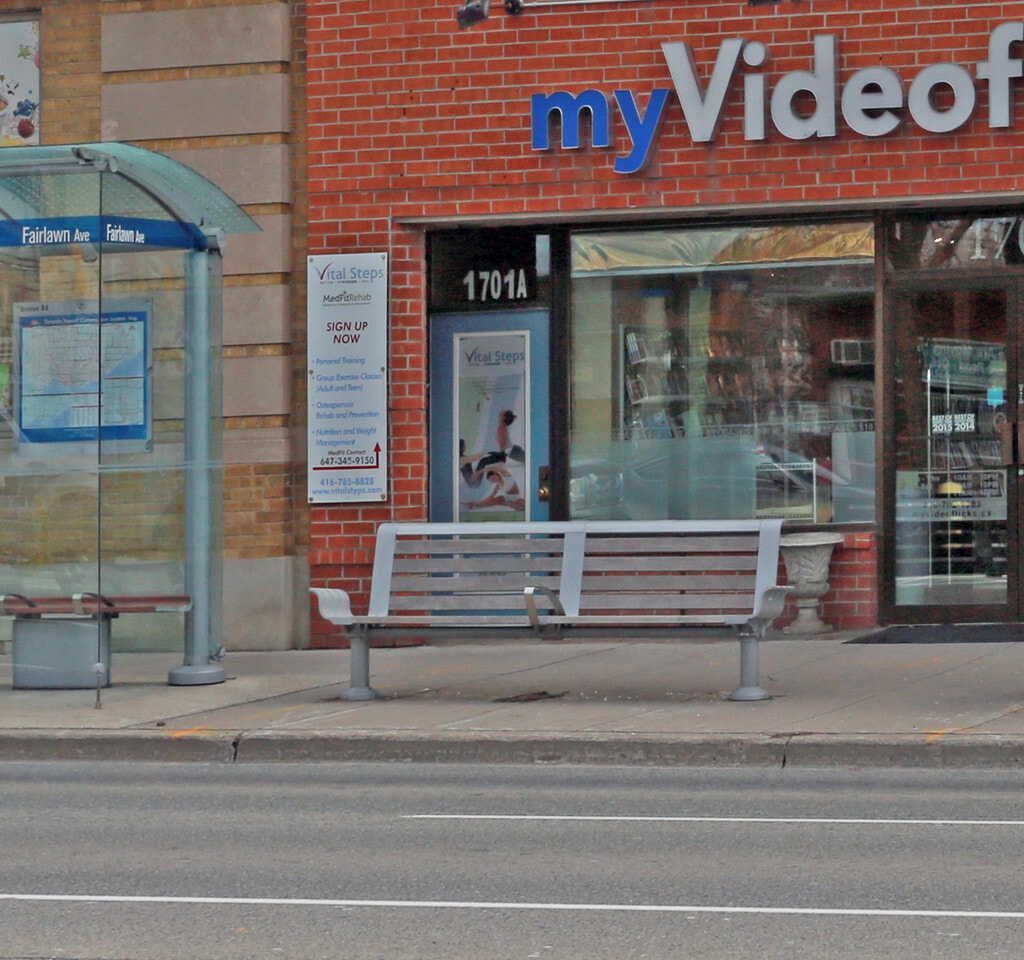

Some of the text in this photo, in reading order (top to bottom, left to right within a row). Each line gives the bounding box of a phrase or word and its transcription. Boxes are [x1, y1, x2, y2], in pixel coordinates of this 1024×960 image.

[22, 226, 90, 244] Fairlawn Ave
[106, 223, 145, 243] Fairlawn Ave
[313, 261, 384, 283] Vital Steps
[463, 268, 528, 301] 1701A
[323, 291, 372, 302] MedFitRehab
[326, 321, 369, 332] SIGN UP
[333, 334, 360, 344] NOW
[342, 356, 366, 365] Training
[494, 350, 526, 365] Steps
